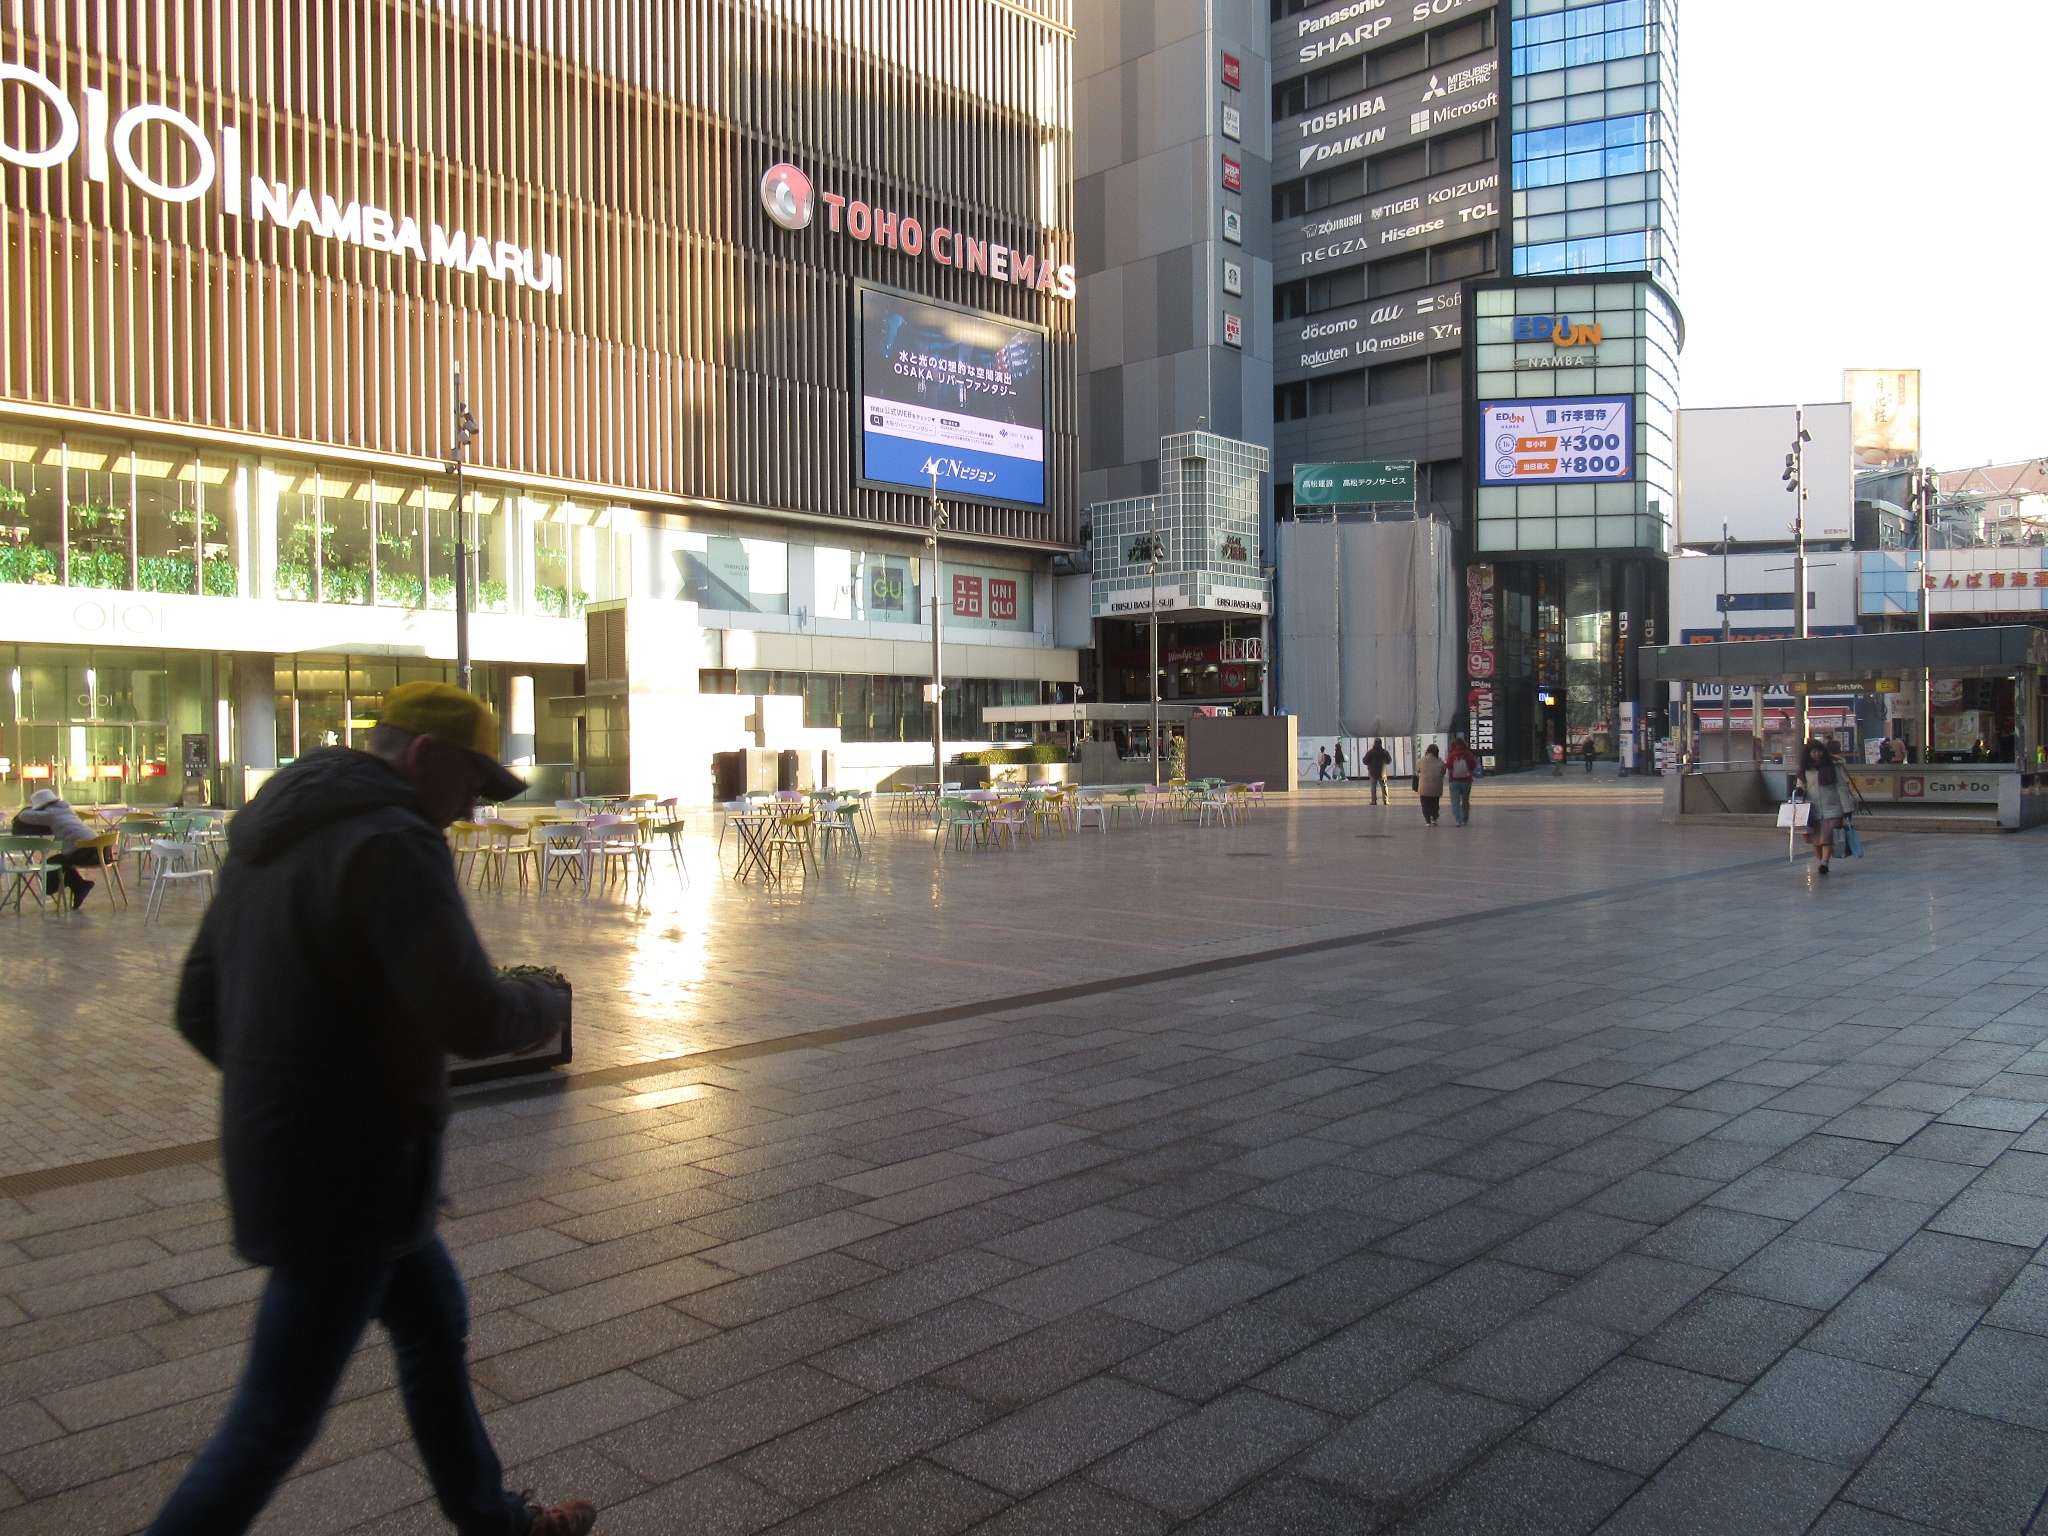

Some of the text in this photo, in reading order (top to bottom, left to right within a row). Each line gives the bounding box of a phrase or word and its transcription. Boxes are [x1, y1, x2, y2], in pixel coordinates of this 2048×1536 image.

[1298, 0, 1386, 37] Panasonic
[1300, 16, 1392, 63] SHARP
[1447, 60, 1498, 86] MITSUBISHI
[1447, 72, 1491, 95] ELECTRIC
[1300, 96, 1386, 138] TOSHIBA
[1433, 92, 1498, 124] Microsoft
[1316, 126, 1387, 162] DAIKIN
[1428, 174, 1499, 205] KOIZUMI
[1383, 196, 1419, 218] TIGER
[1458, 202, 1499, 223] TCL
[251, 175, 426, 262] NAMBA
[430, 223, 563, 296] MARUI
[1381, 218, 1445, 245] Hisense
[822, 192, 1077, 300] TOHO CINEMAS
[1301, 237, 1368, 265] REGZA
[1369, 304, 1405, 325] au
[1301, 317, 1359, 341] docomo
[1512, 315, 1603, 348] EDION
[1355, 330, 1425, 356] UQ mobile
[1300, 346, 1348, 367] Rakuten
[1528, 355, 1585, 368] NAMBA
[893, 364, 934, 382] OSAKA
[1495, 412, 1525, 424] EDION
[1561, 409, 1607, 422] 行李寄存
[1560, 434, 1620, 452] ¥300
[1560, 455, 1620, 473] ¥800
[873, 578, 902, 599] GU
[991, 583, 1012, 600] UNI
[991, 600, 1014, 617] QLO
[1696, 683, 1751, 696] Moey
[1478, 693, 1493, 750] TAX FREE
